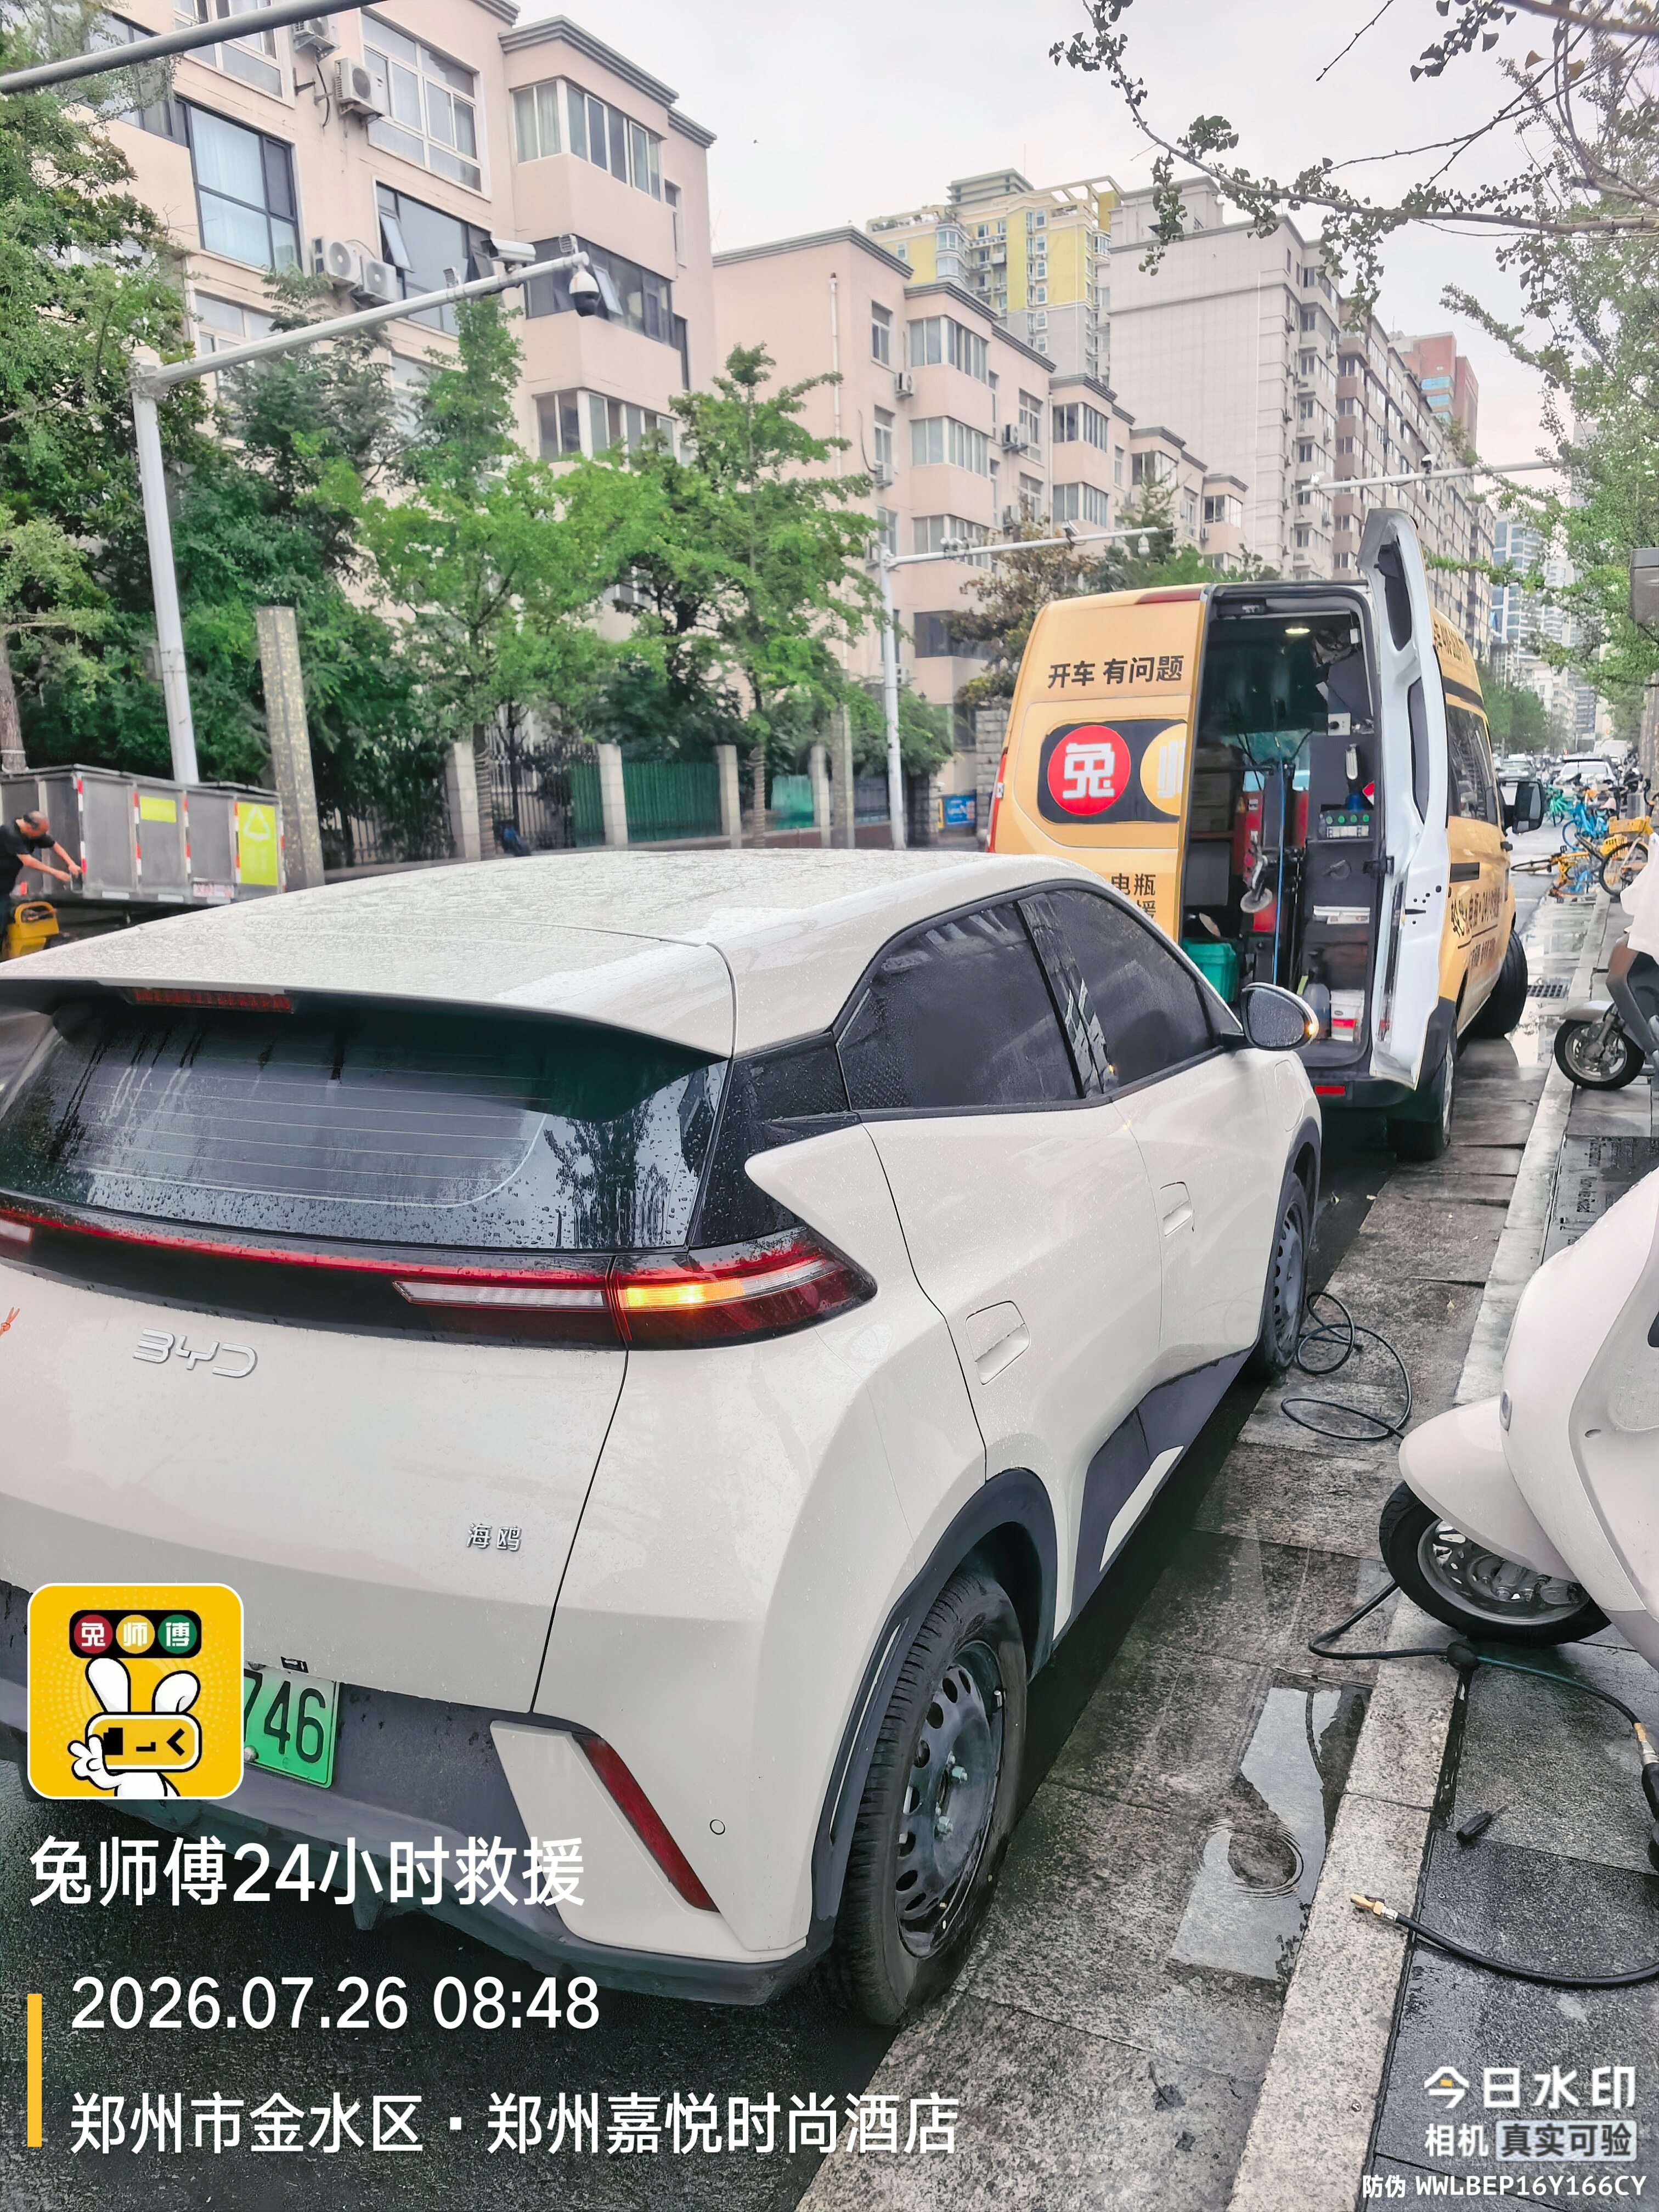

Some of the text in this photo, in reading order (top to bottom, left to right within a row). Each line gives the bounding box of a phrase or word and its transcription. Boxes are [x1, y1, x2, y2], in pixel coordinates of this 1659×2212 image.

[1047, 655, 1184, 689] 开车 有问题
[1111, 873, 1156, 896] 电瓶
[132, 1328, 258, 1378] BYD
[466, 1522, 522, 1552] 海鸥
